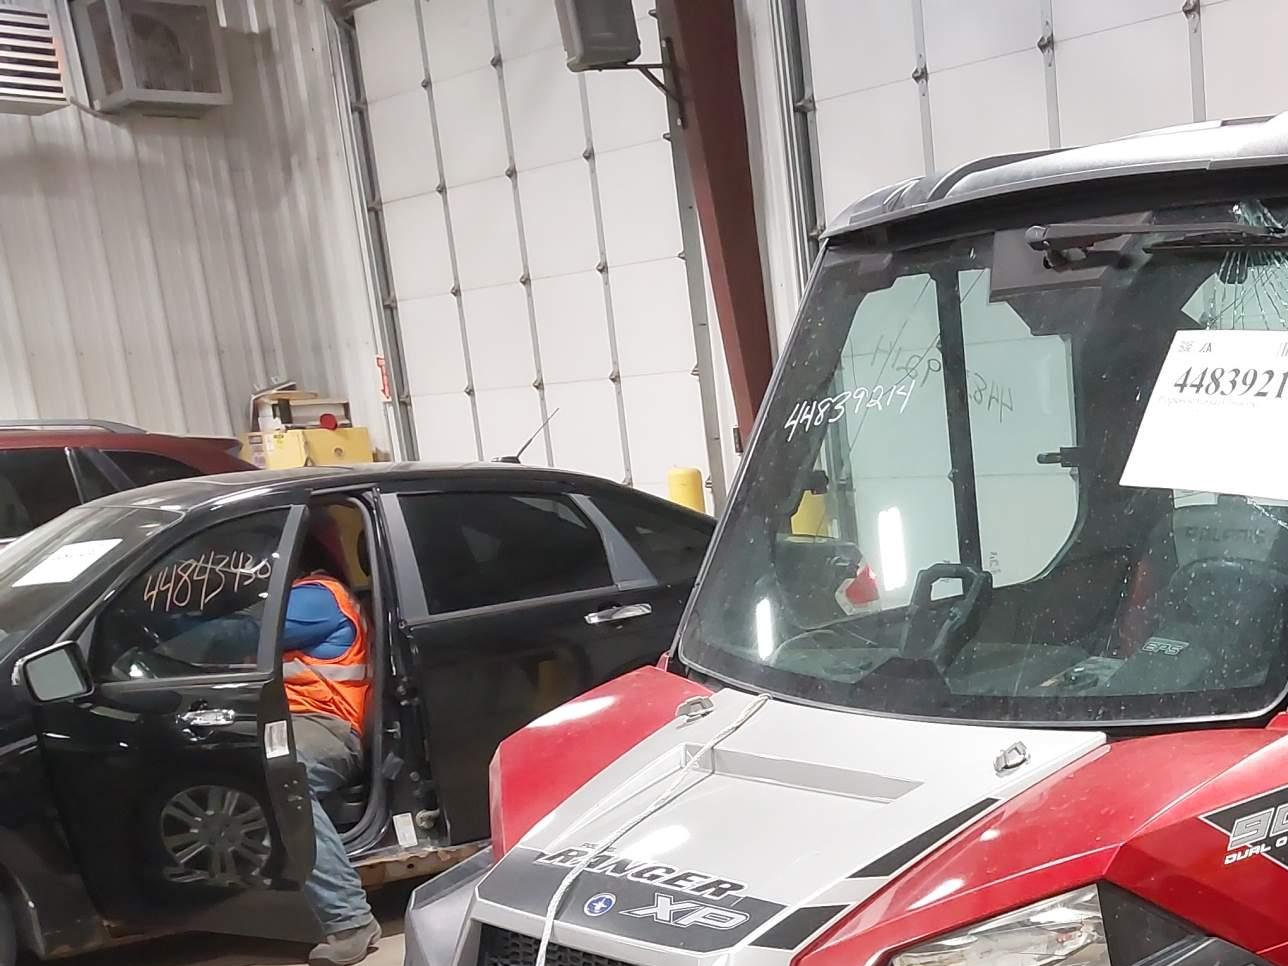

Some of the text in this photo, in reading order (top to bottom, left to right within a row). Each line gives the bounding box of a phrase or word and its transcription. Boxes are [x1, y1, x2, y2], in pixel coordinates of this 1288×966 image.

[784, 379, 916, 442] 44839214
[143, 551, 272, 612] 44843430
[536, 847, 748, 900] RANGER
[1224, 843, 1272, 865] DUAL
[618, 893, 750, 930] XP
